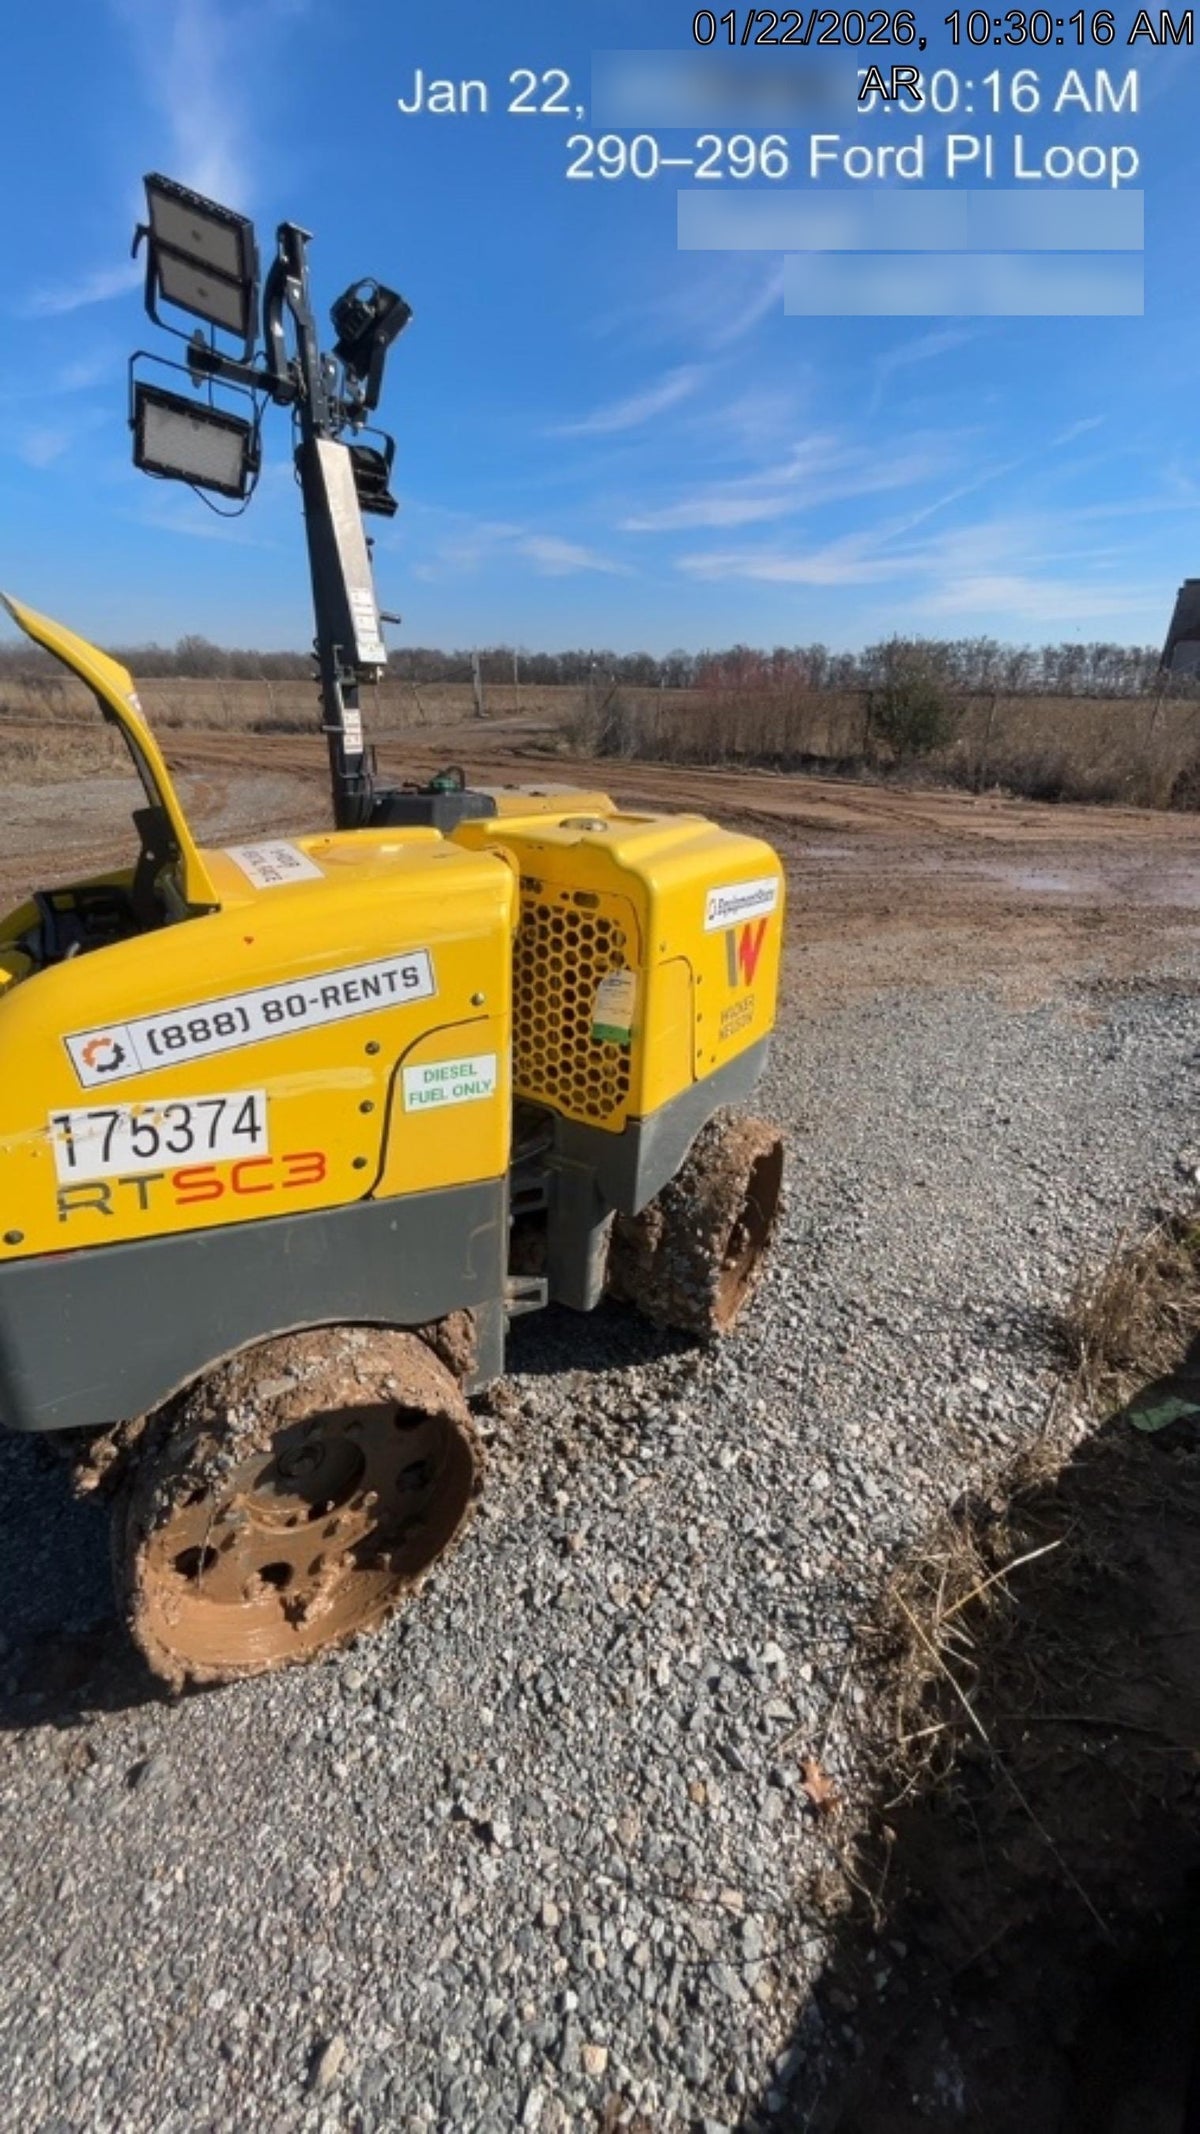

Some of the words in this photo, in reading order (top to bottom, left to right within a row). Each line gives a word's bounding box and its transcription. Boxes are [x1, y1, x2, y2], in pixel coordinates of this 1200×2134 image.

[146, 1006, 250, 1056] (888)
[264, 965, 420, 1024] 80-RENTS
[409, 1087, 448, 1106] FUEL
[452, 1079, 492, 1098] ONLY
[423, 1063, 477, 1084] DIESEL
[53, 1095, 262, 1167] 175374
